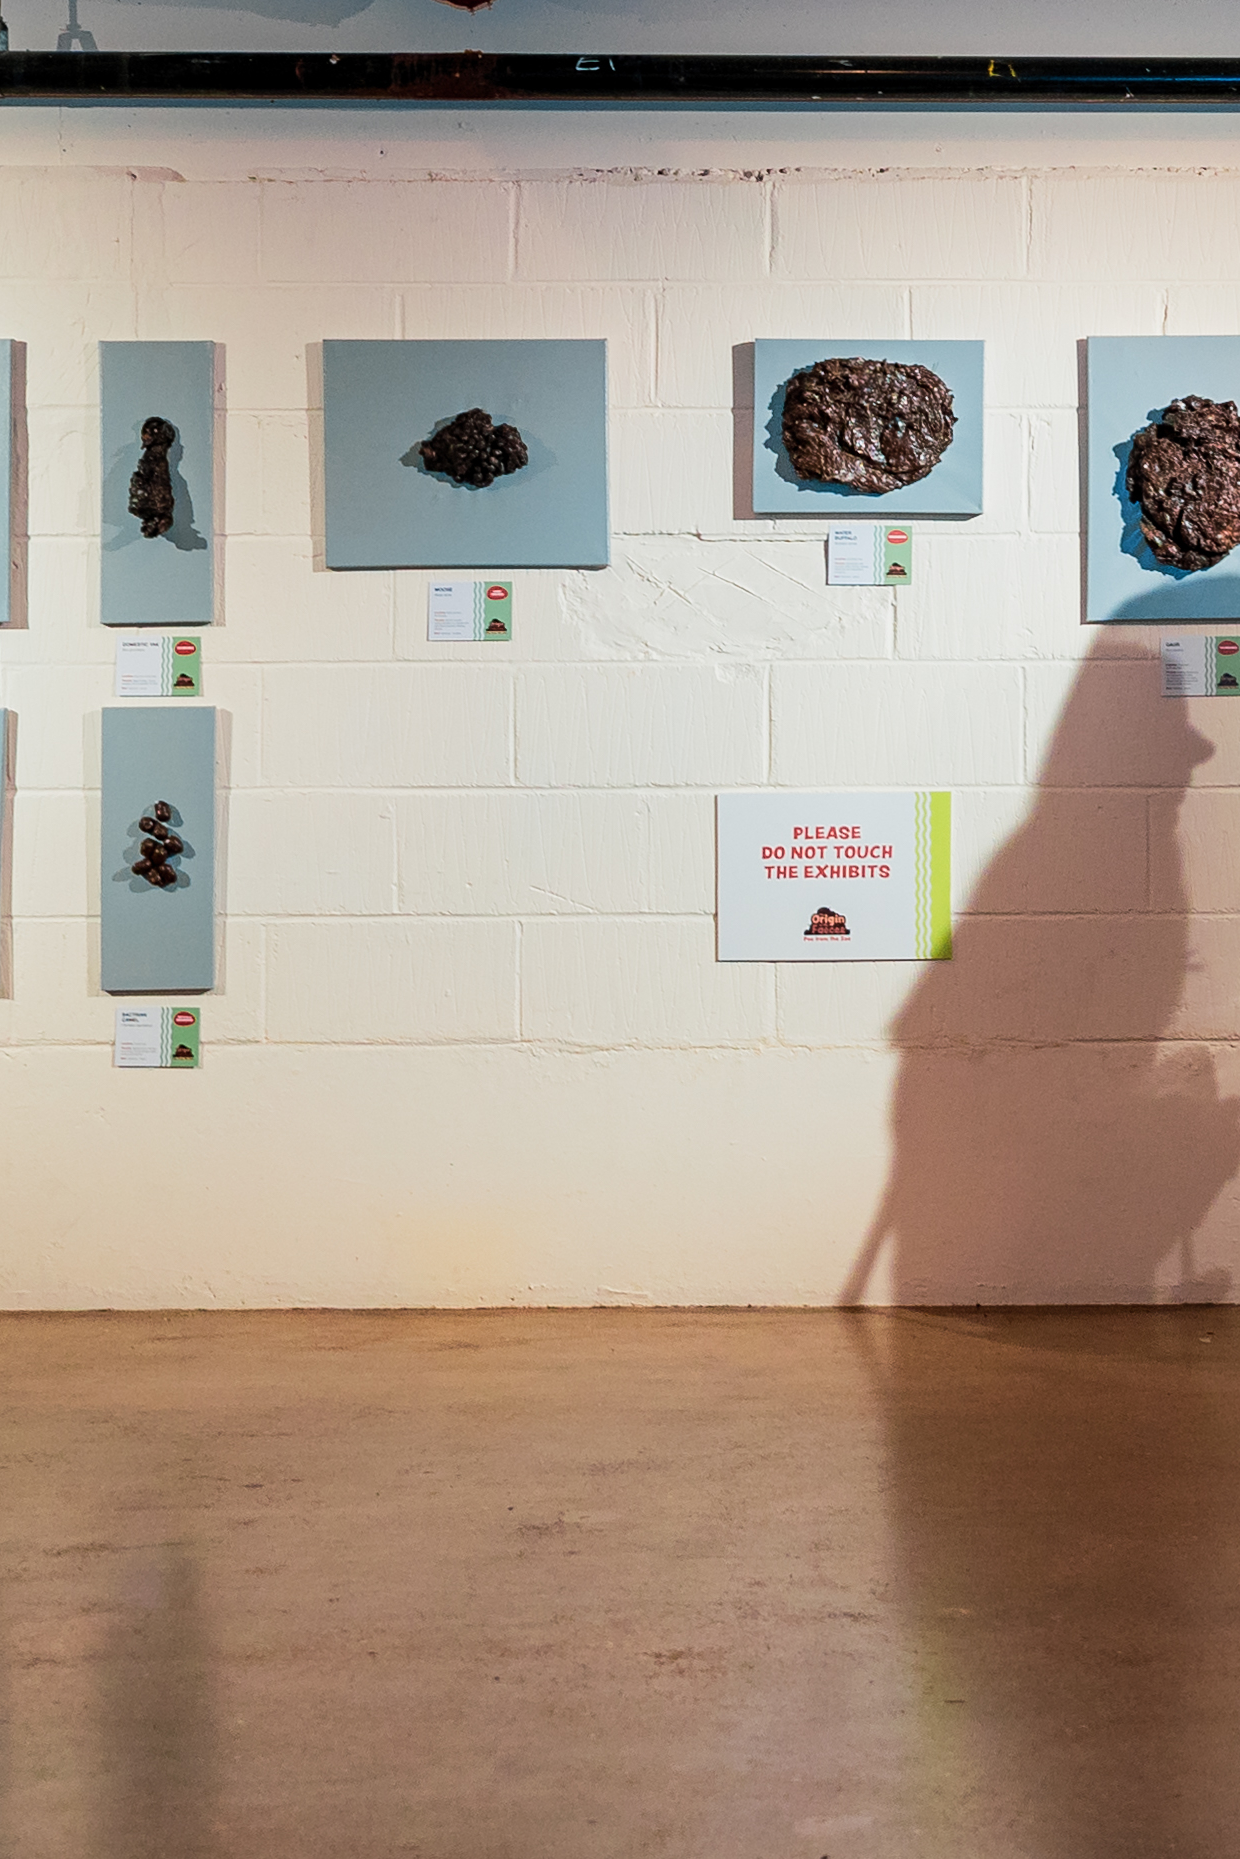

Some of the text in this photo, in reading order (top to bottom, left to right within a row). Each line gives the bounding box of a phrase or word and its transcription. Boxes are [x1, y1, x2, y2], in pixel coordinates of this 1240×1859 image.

[793, 826, 861, 840] PLEASE
[761, 845, 893, 860] DO NOT TOUCH
[764, 864, 891, 880] THE EXHIBITS
[812, 913, 845, 926] Origin
[811, 925, 846, 934] Faeces
